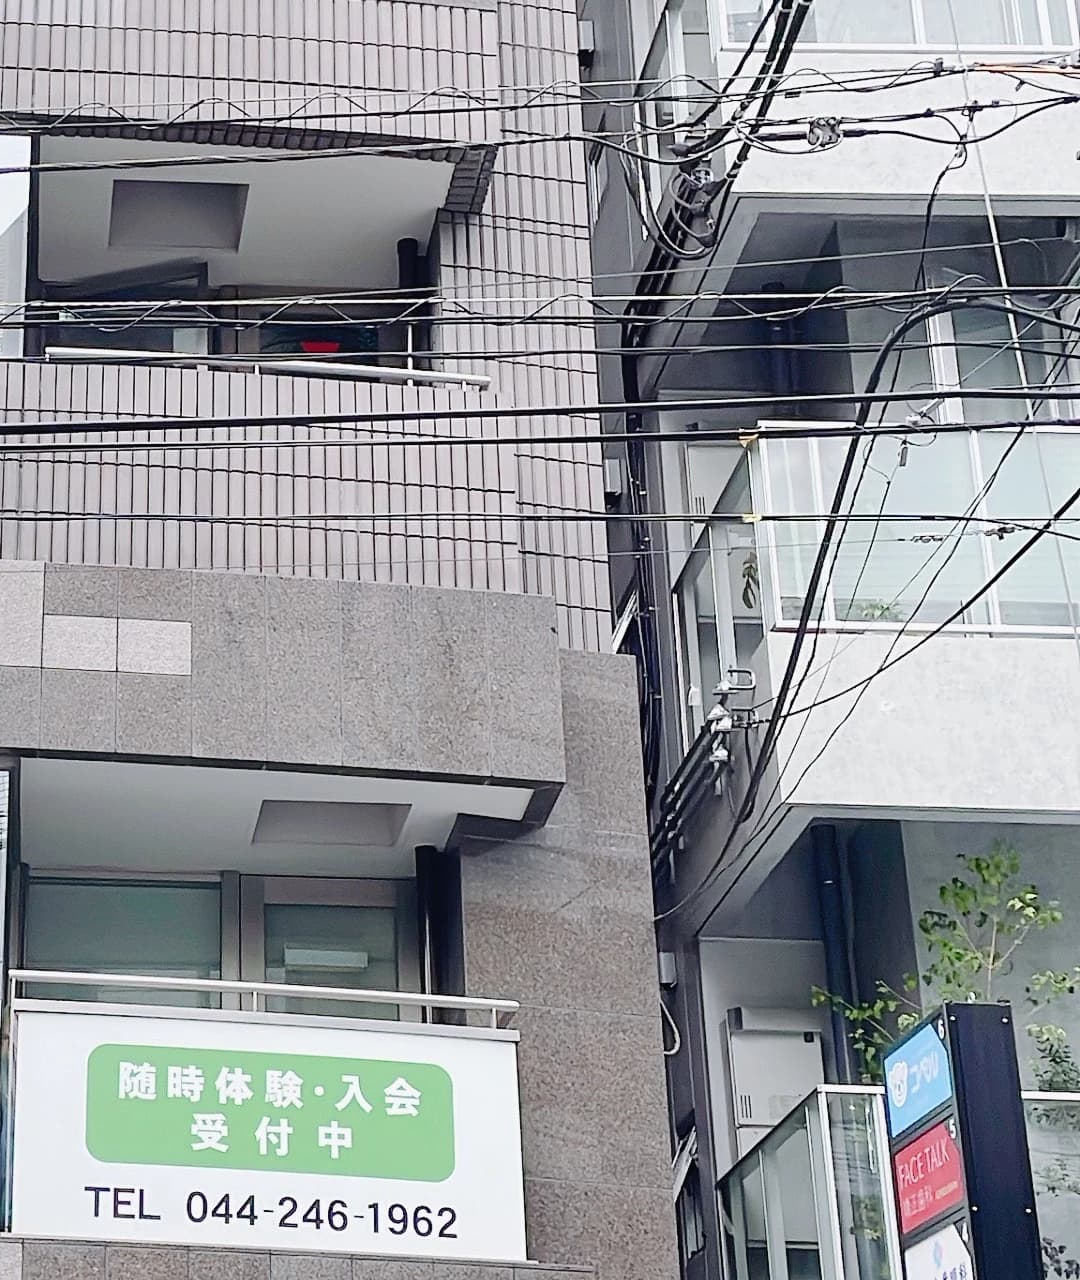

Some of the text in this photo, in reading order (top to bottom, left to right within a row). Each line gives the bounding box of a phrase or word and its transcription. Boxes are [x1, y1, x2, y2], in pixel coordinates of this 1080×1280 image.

[937, 1019, 945, 1040] 6
[117, 1060, 423, 1117] 随時体験・入会
[190, 1113, 353, 1160] 受付中
[948, 1119, 957, 1139] 5
[898, 1137, 950, 1190] FACE TALK
[84, 1186, 459, 1239] TEL 044-246-1962
